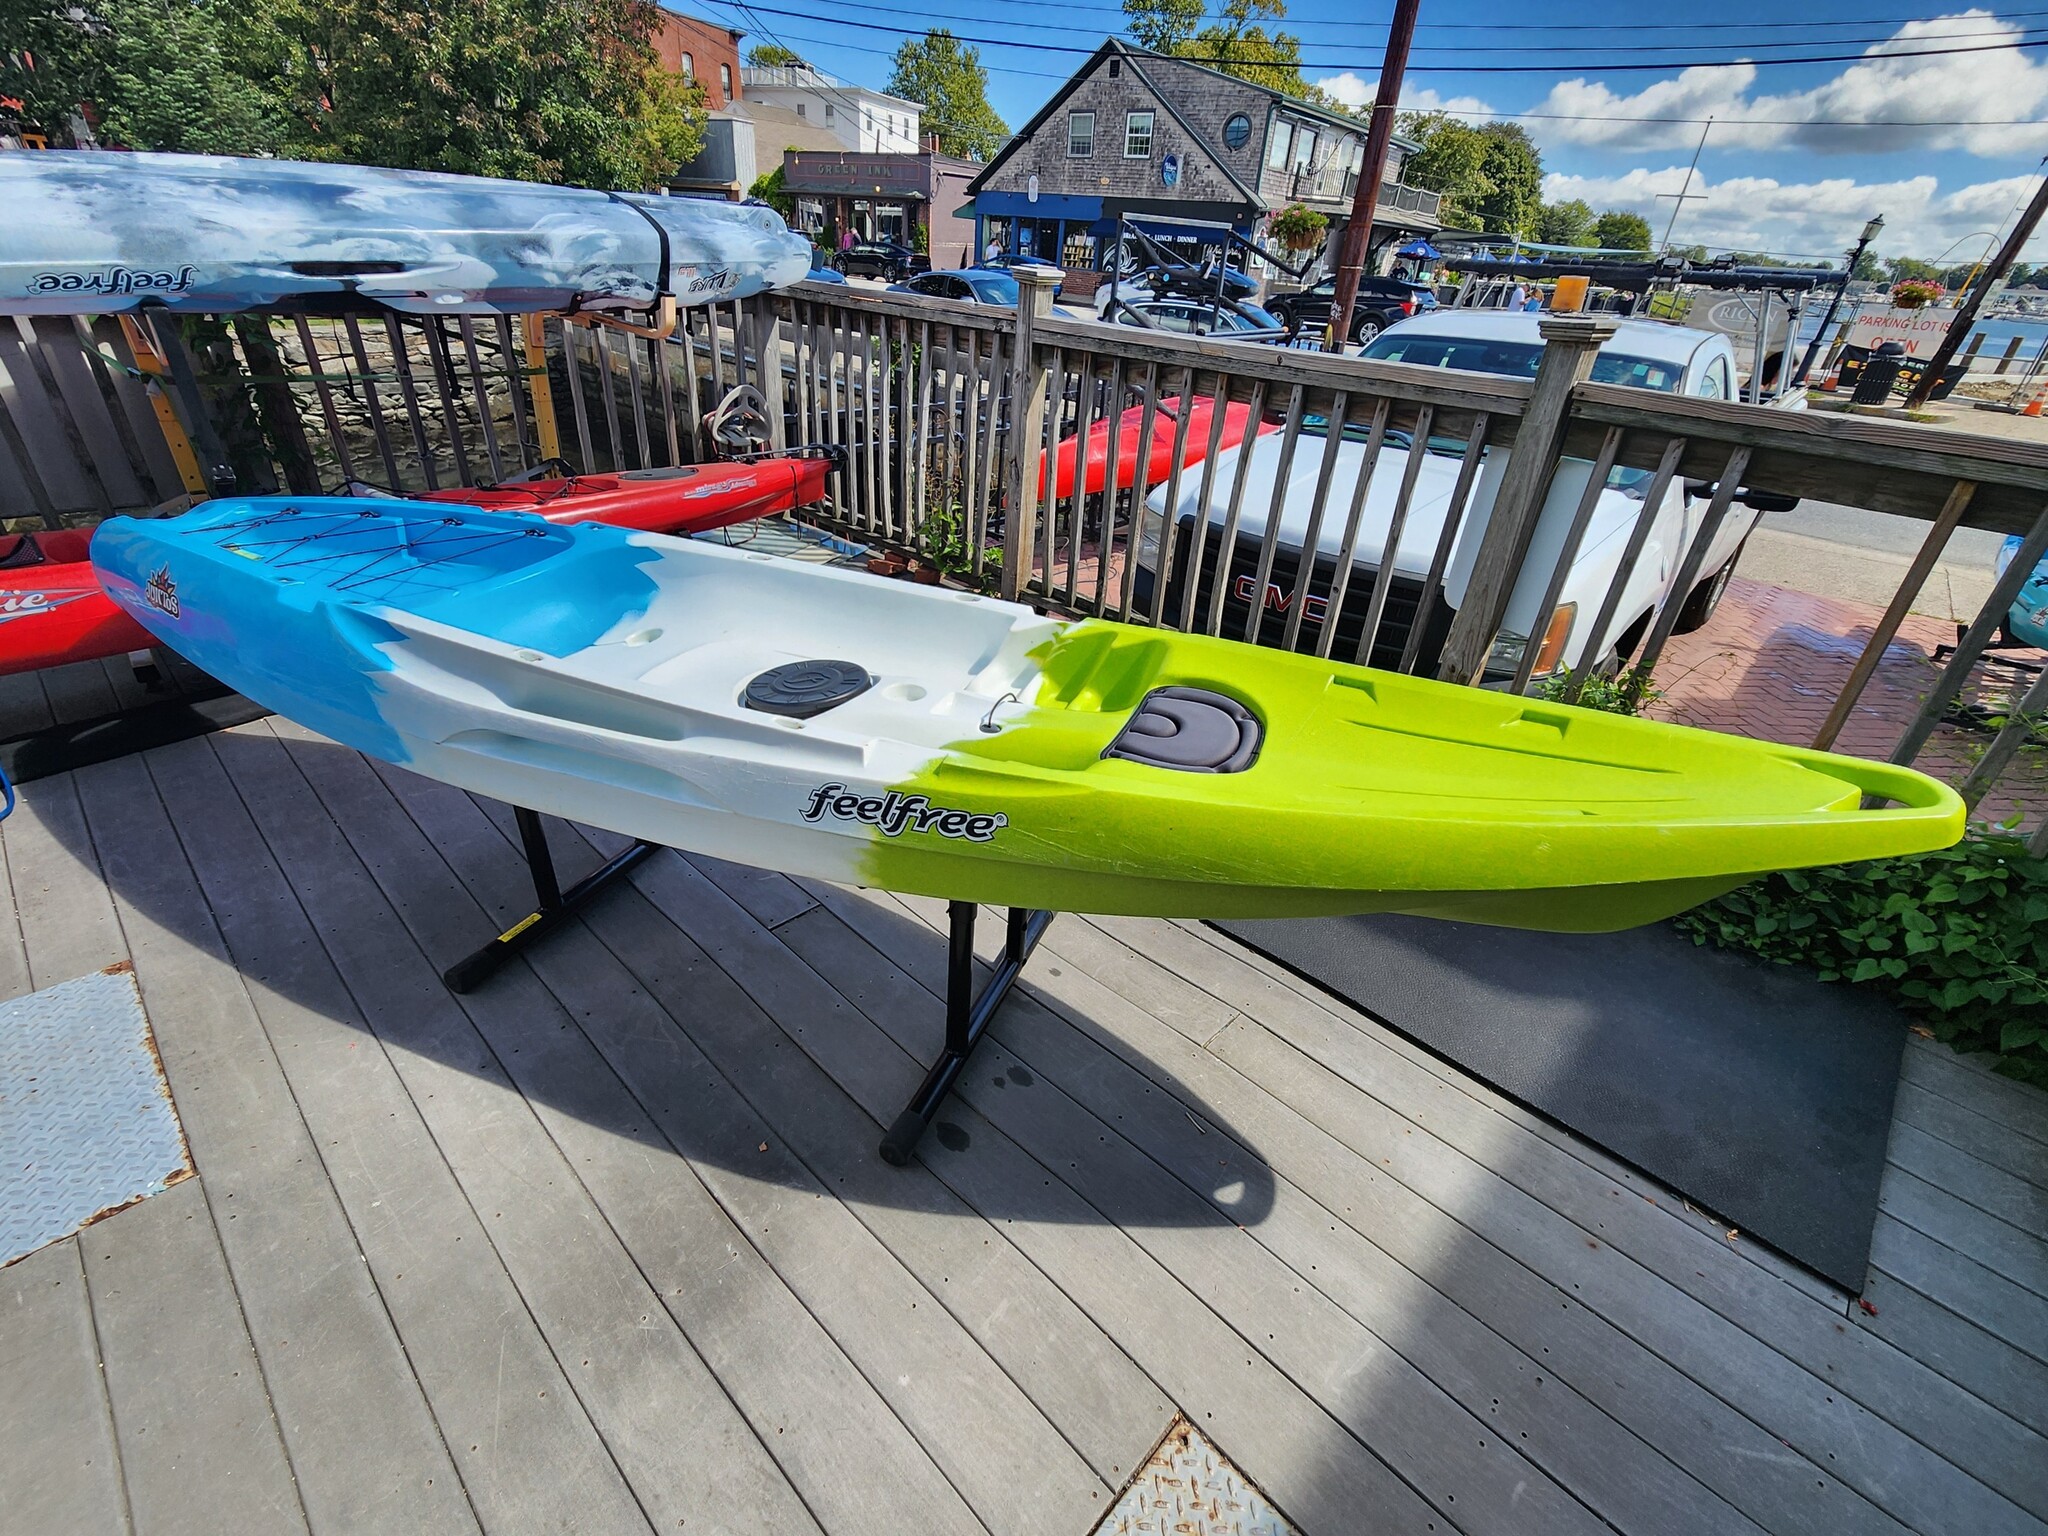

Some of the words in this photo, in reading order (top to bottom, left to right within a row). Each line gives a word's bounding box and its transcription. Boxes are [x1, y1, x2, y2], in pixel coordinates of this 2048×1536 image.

[817, 163, 858, 175] GREEN
[868, 164, 892, 177] INK
[1154, 234, 1172, 242] LUNCH
[1176, 236, 1198, 244] DINNER
[31, 265, 200, 296] feelfree
[1858, 315, 1911, 330] PARKING
[1912, 320, 1939, 331] LOT
[1870, 336, 1920, 353] ON
[1234, 574, 1329, 623] GMC
[799, 782, 999, 842] feelfree
